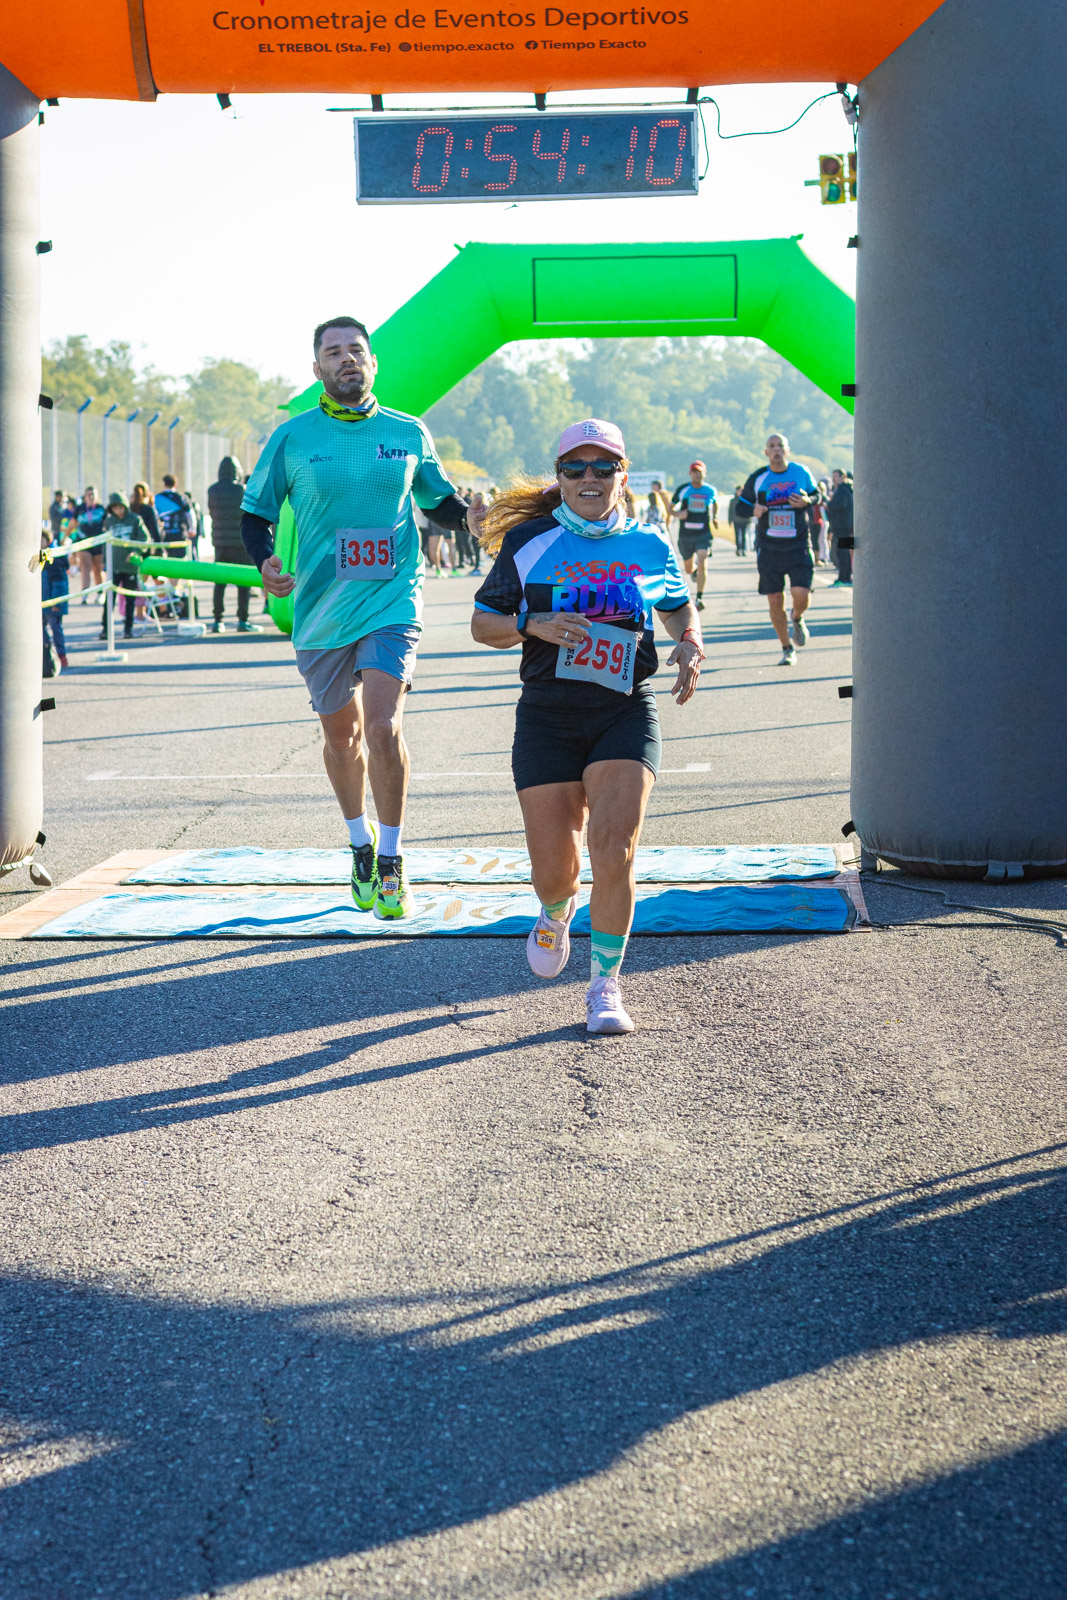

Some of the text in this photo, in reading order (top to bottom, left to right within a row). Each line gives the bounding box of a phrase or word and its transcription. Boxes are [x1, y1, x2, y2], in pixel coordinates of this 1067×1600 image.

[213, 7, 689, 33] Cronometraje de Eventos Deportivos
[258, 39, 647, 53] EL TREBOL (Sta. Fe) tiempo.exacto Tiempo Exacto
[377, 444, 408, 460] km
[774, 515, 791, 526] 357
[347, 539, 390, 567] 335
[552, 584, 643, 616] RUN
[573, 634, 625, 675] 259
[622, 642, 633, 680] EXACTO
